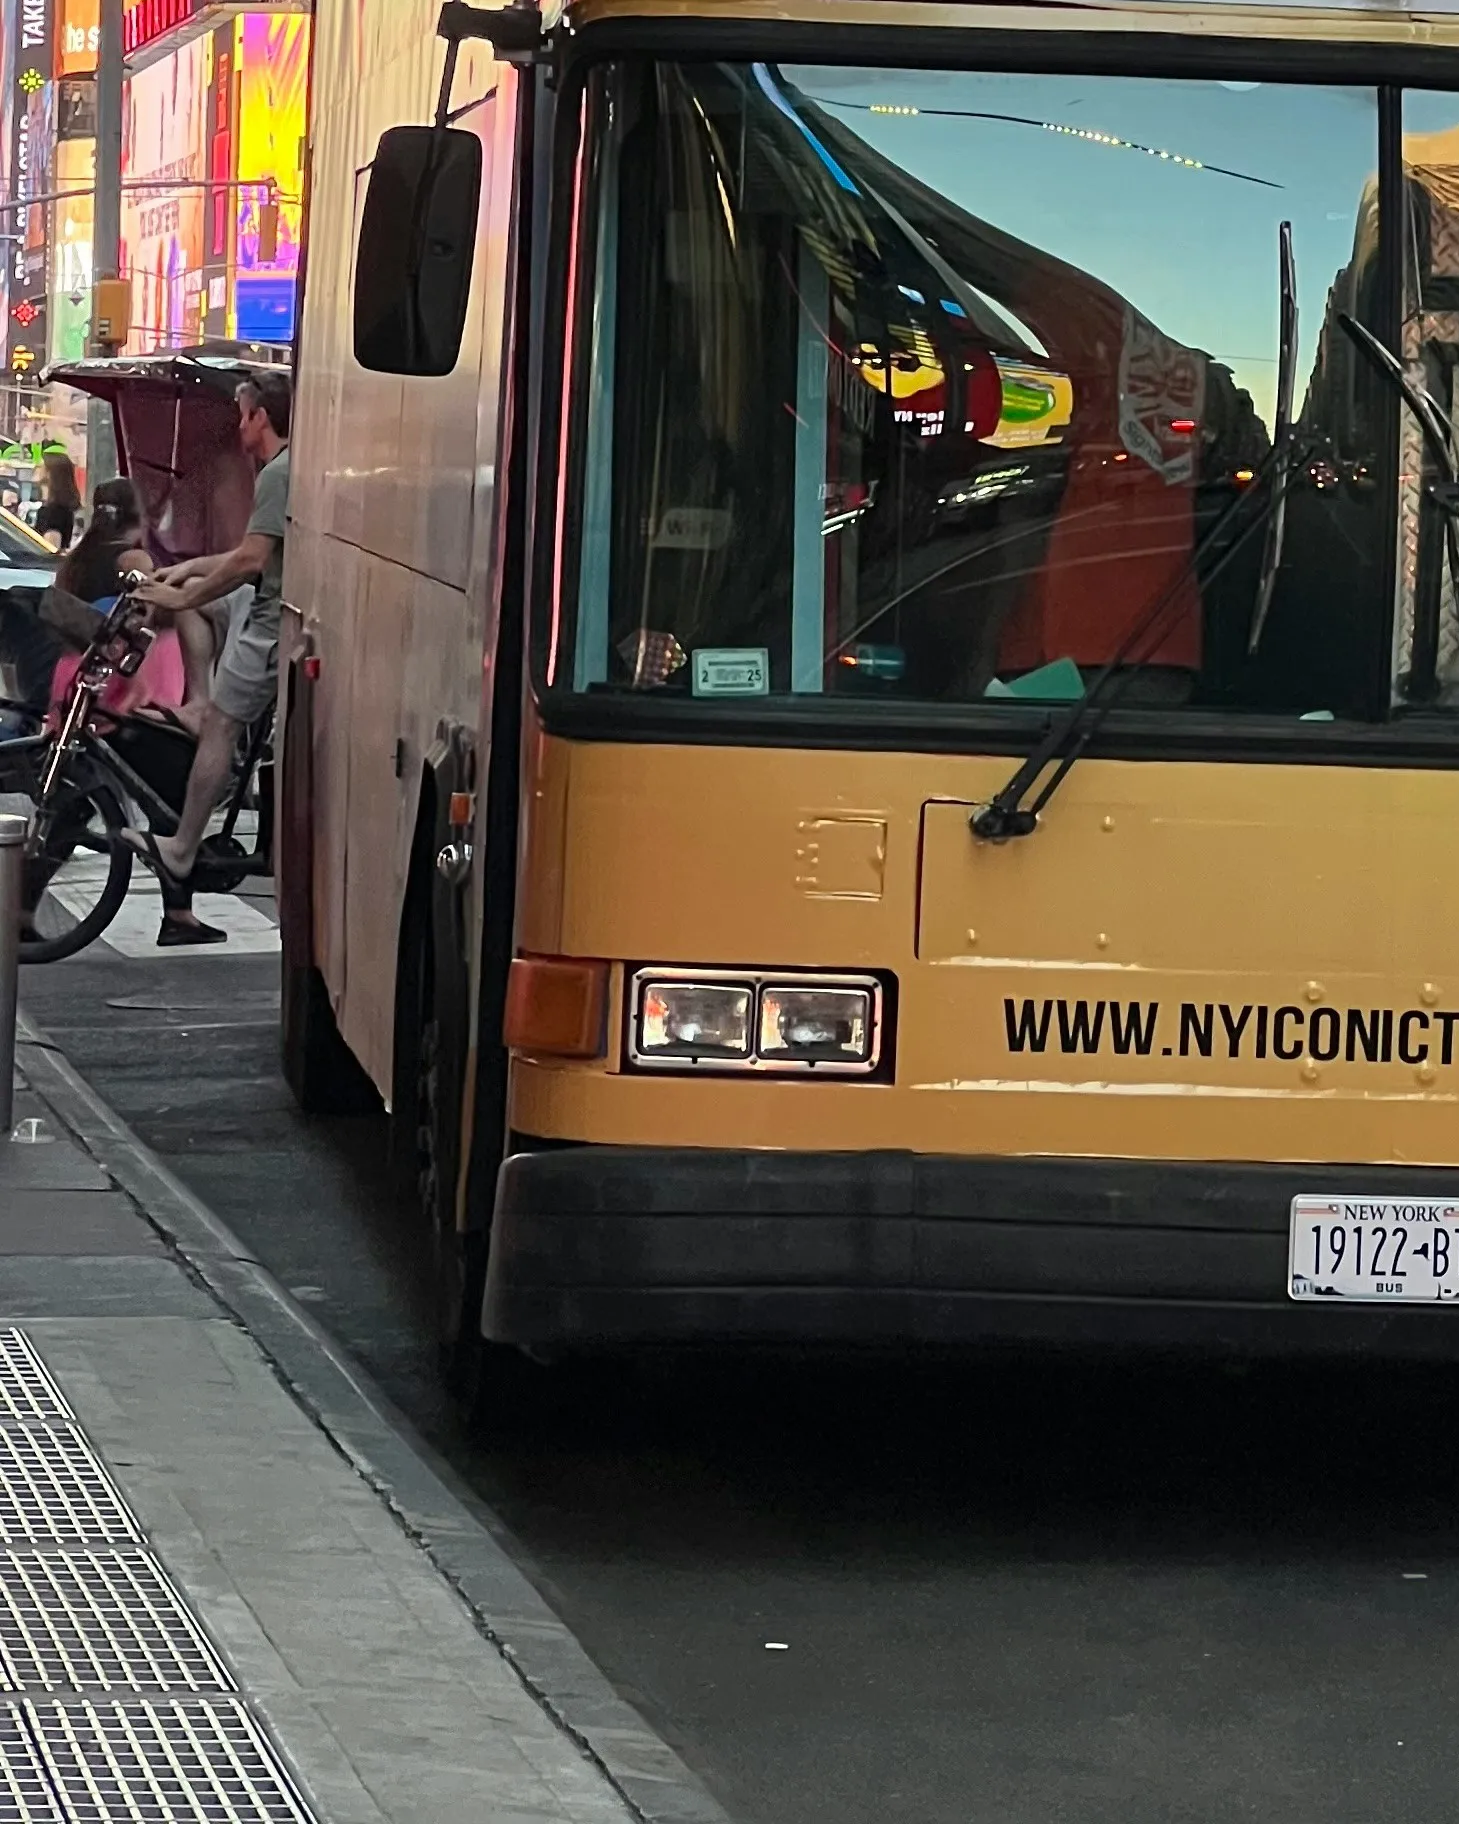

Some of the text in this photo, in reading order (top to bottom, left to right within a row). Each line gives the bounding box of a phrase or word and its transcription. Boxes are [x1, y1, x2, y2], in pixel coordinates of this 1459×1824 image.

[1344, 1204, 1441, 1222] NEW YORK
[1376, 1282, 1403, 1293] BUS
